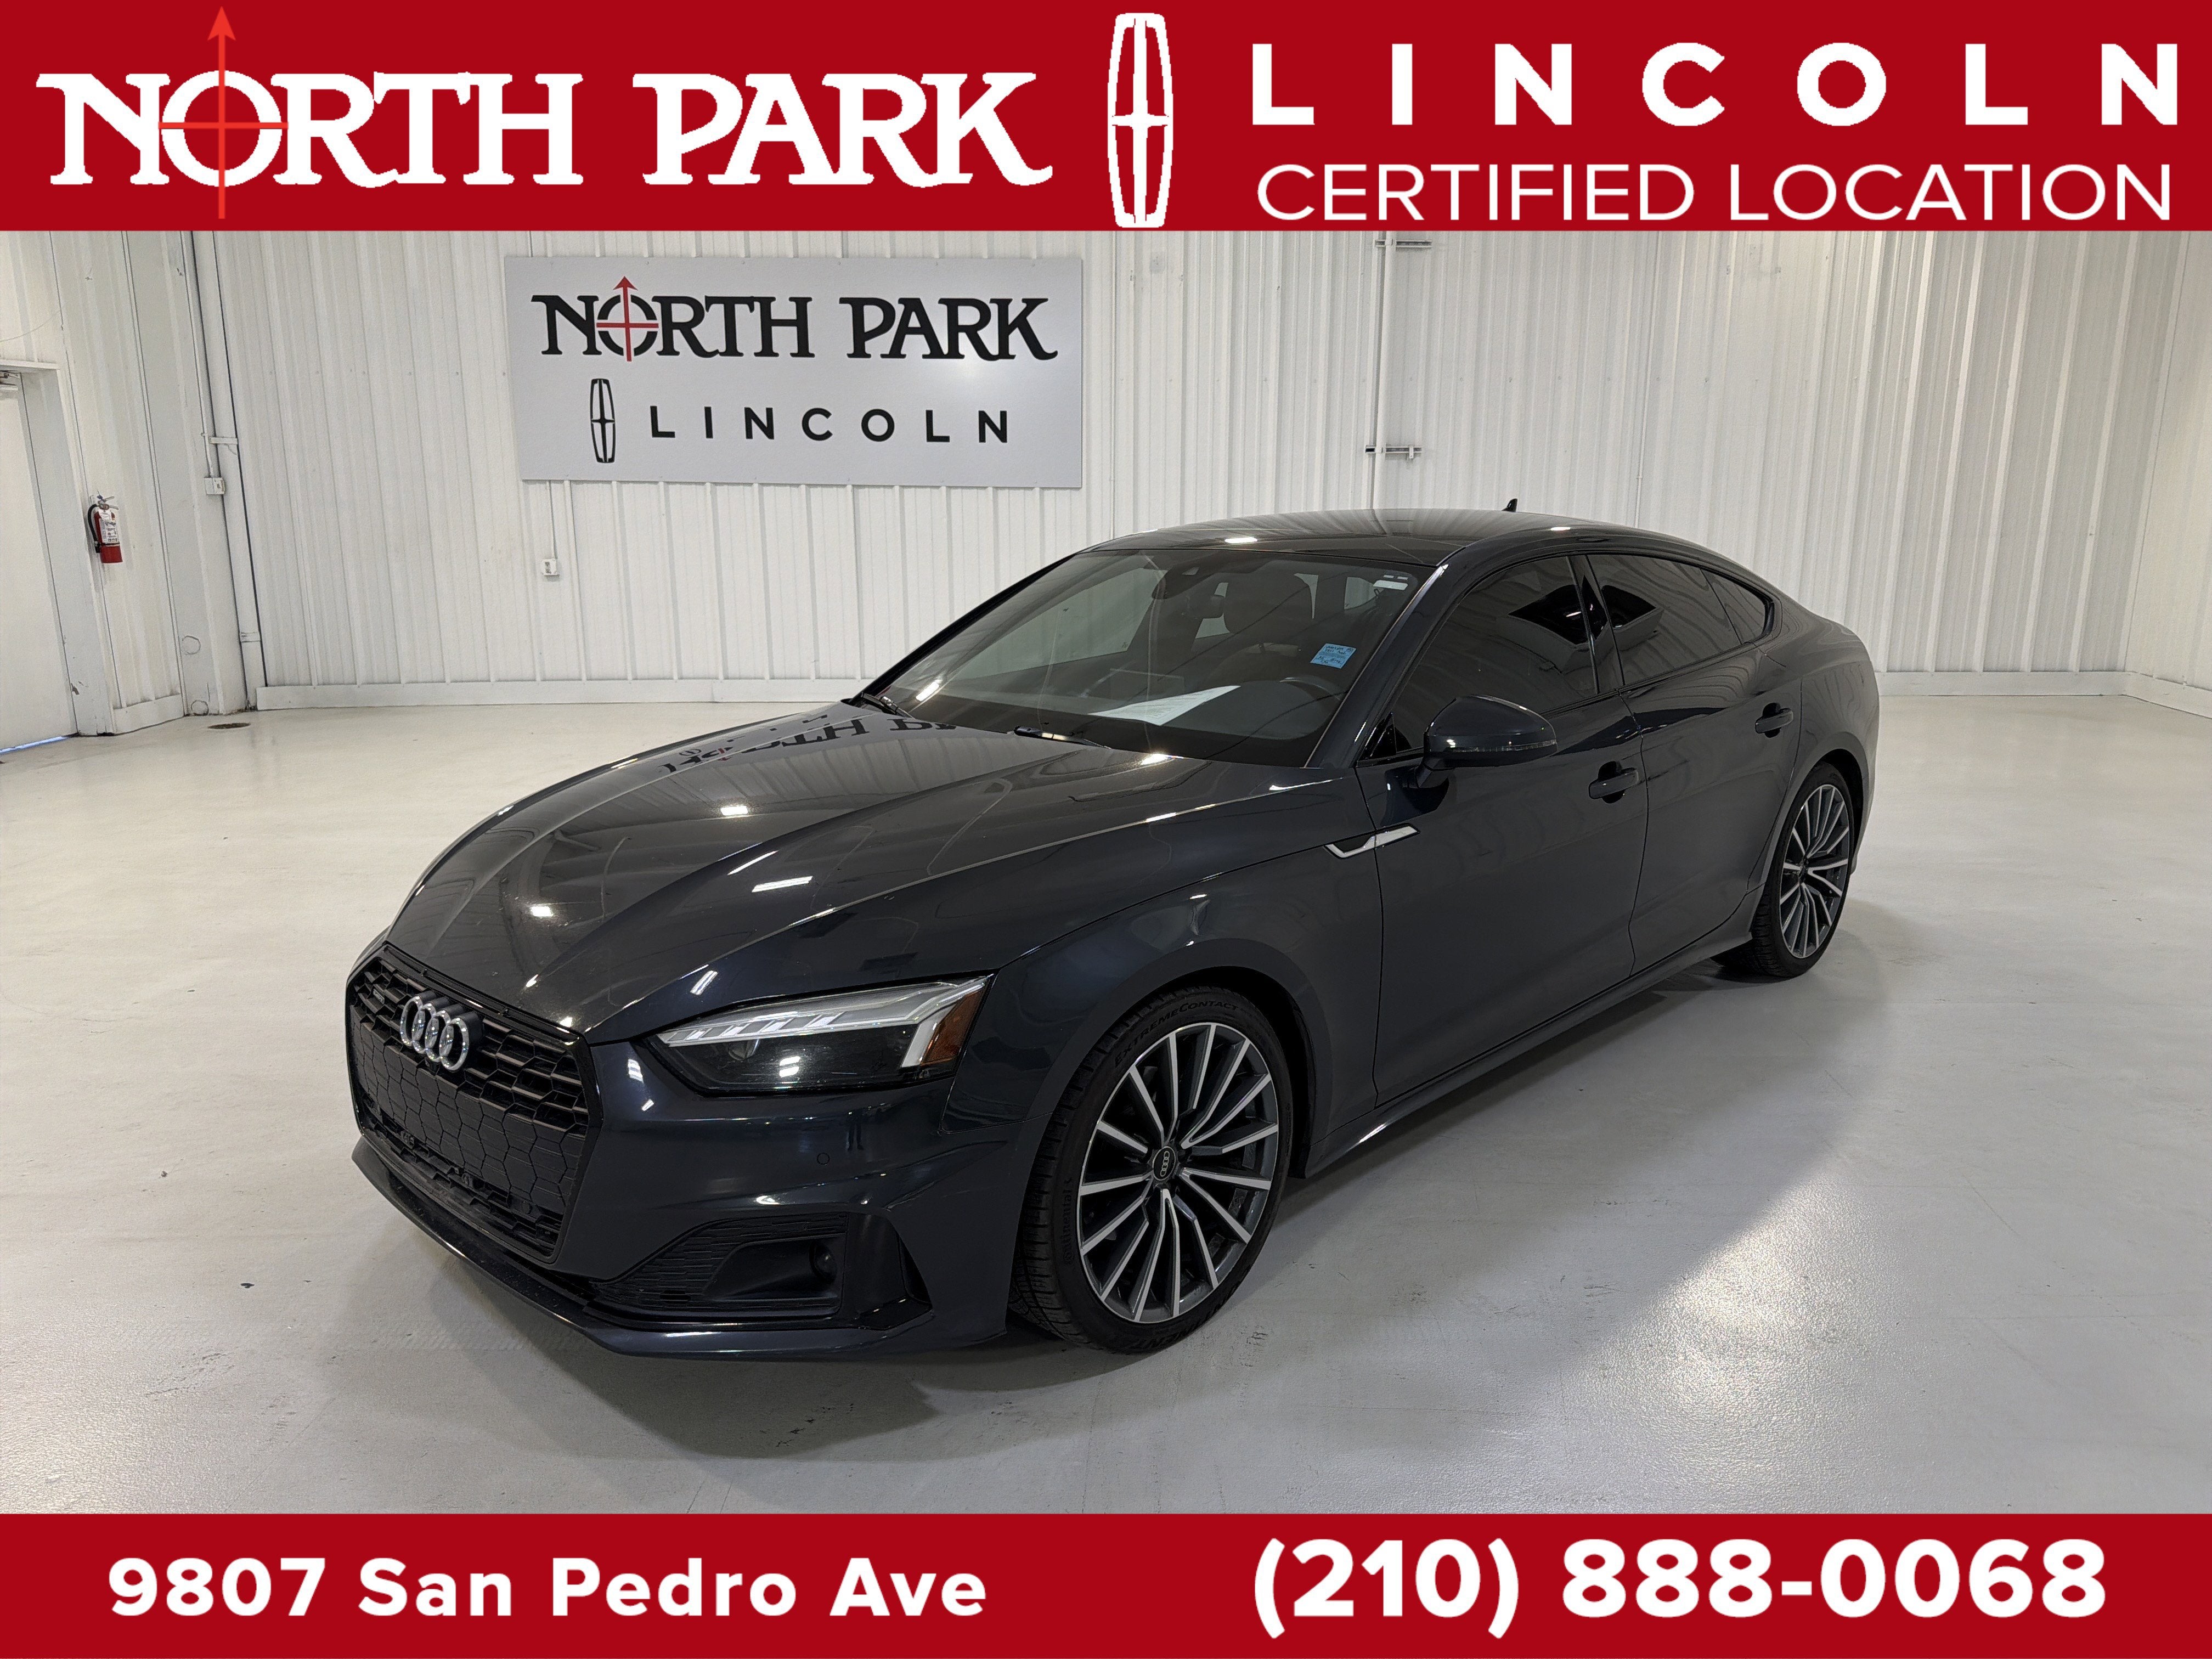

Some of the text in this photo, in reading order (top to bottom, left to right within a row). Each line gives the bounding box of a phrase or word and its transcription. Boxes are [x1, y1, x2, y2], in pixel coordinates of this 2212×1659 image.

[531, 294, 1058, 361] NORTH PARK
[650, 405, 1007, 443] LINCOLN
